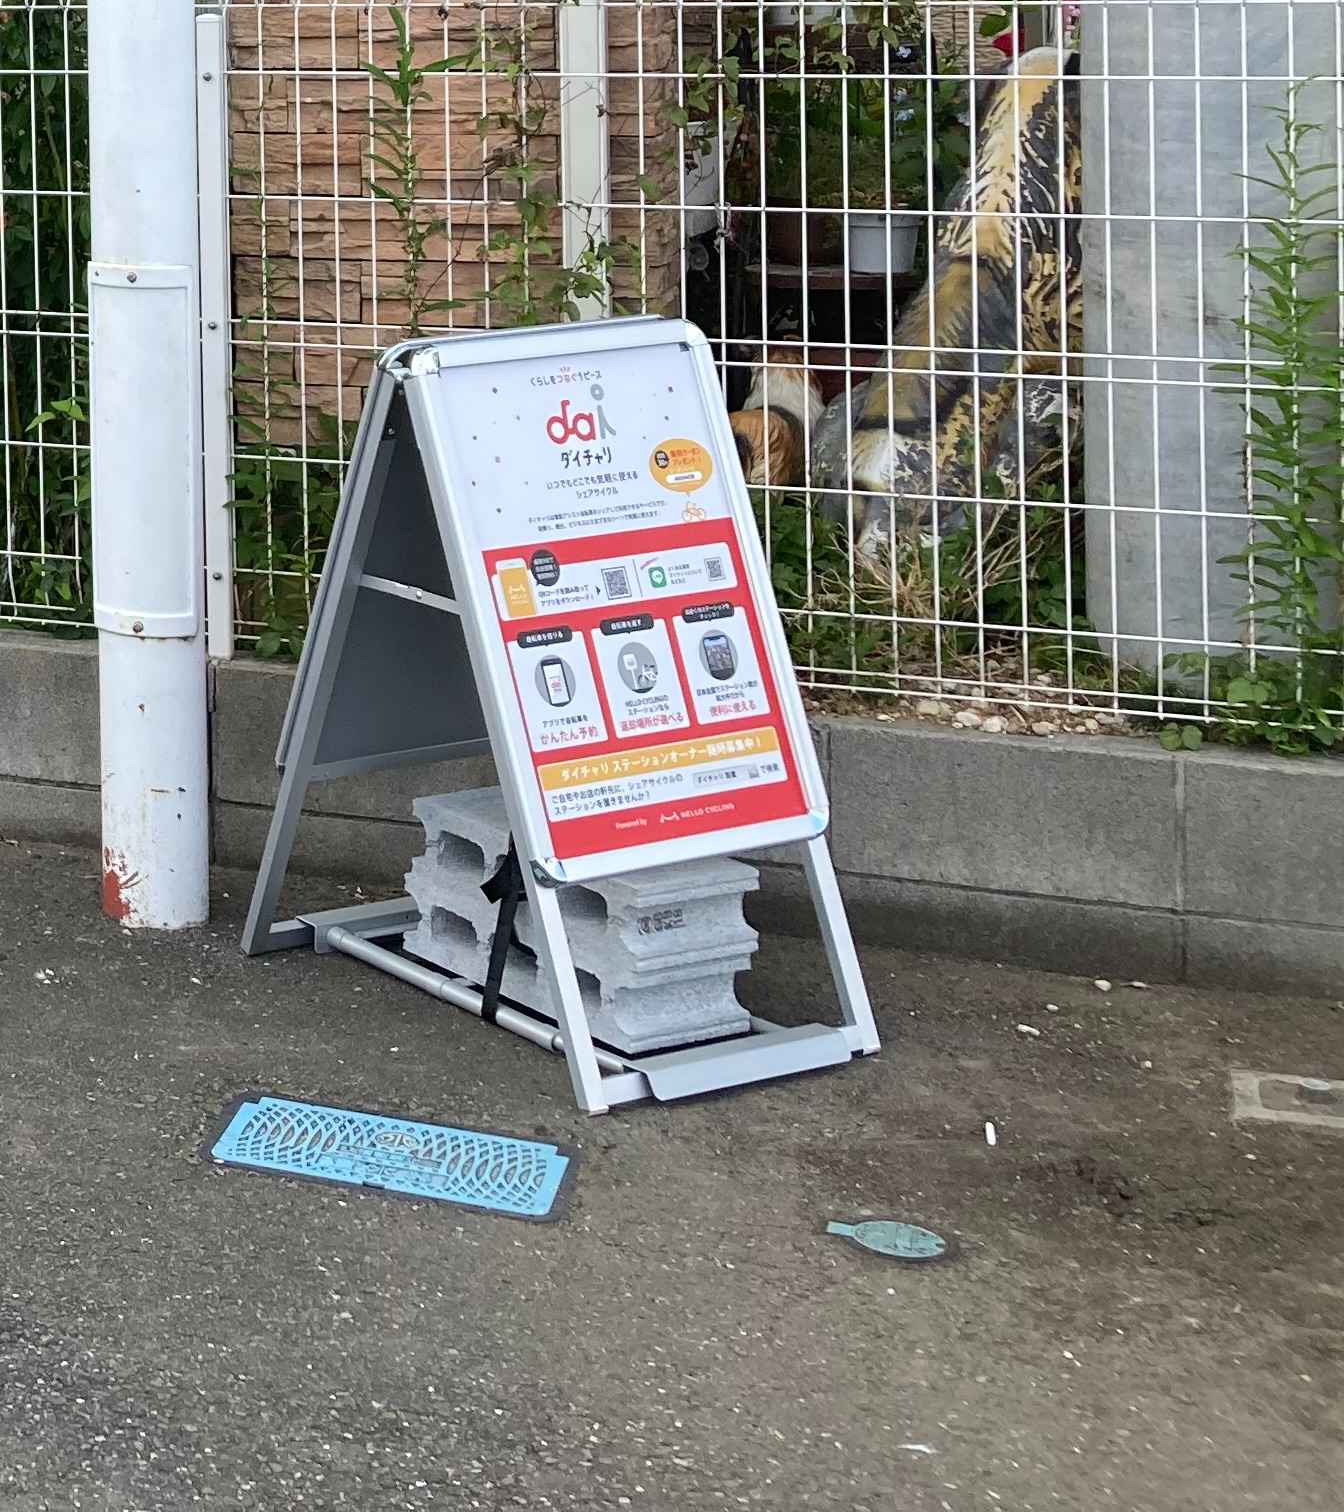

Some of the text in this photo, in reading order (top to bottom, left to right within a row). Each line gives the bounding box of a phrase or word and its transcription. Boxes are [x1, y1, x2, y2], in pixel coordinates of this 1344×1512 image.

[561, 447, 612, 469] ダイチャリ
[547, 471, 638, 489] いつでもどこでも気軽に使える
[576, 487, 618, 500] シェアサイクル
[540, 725, 599, 744] かんたん予約
[561, 763, 609, 781] ダイチャリ
